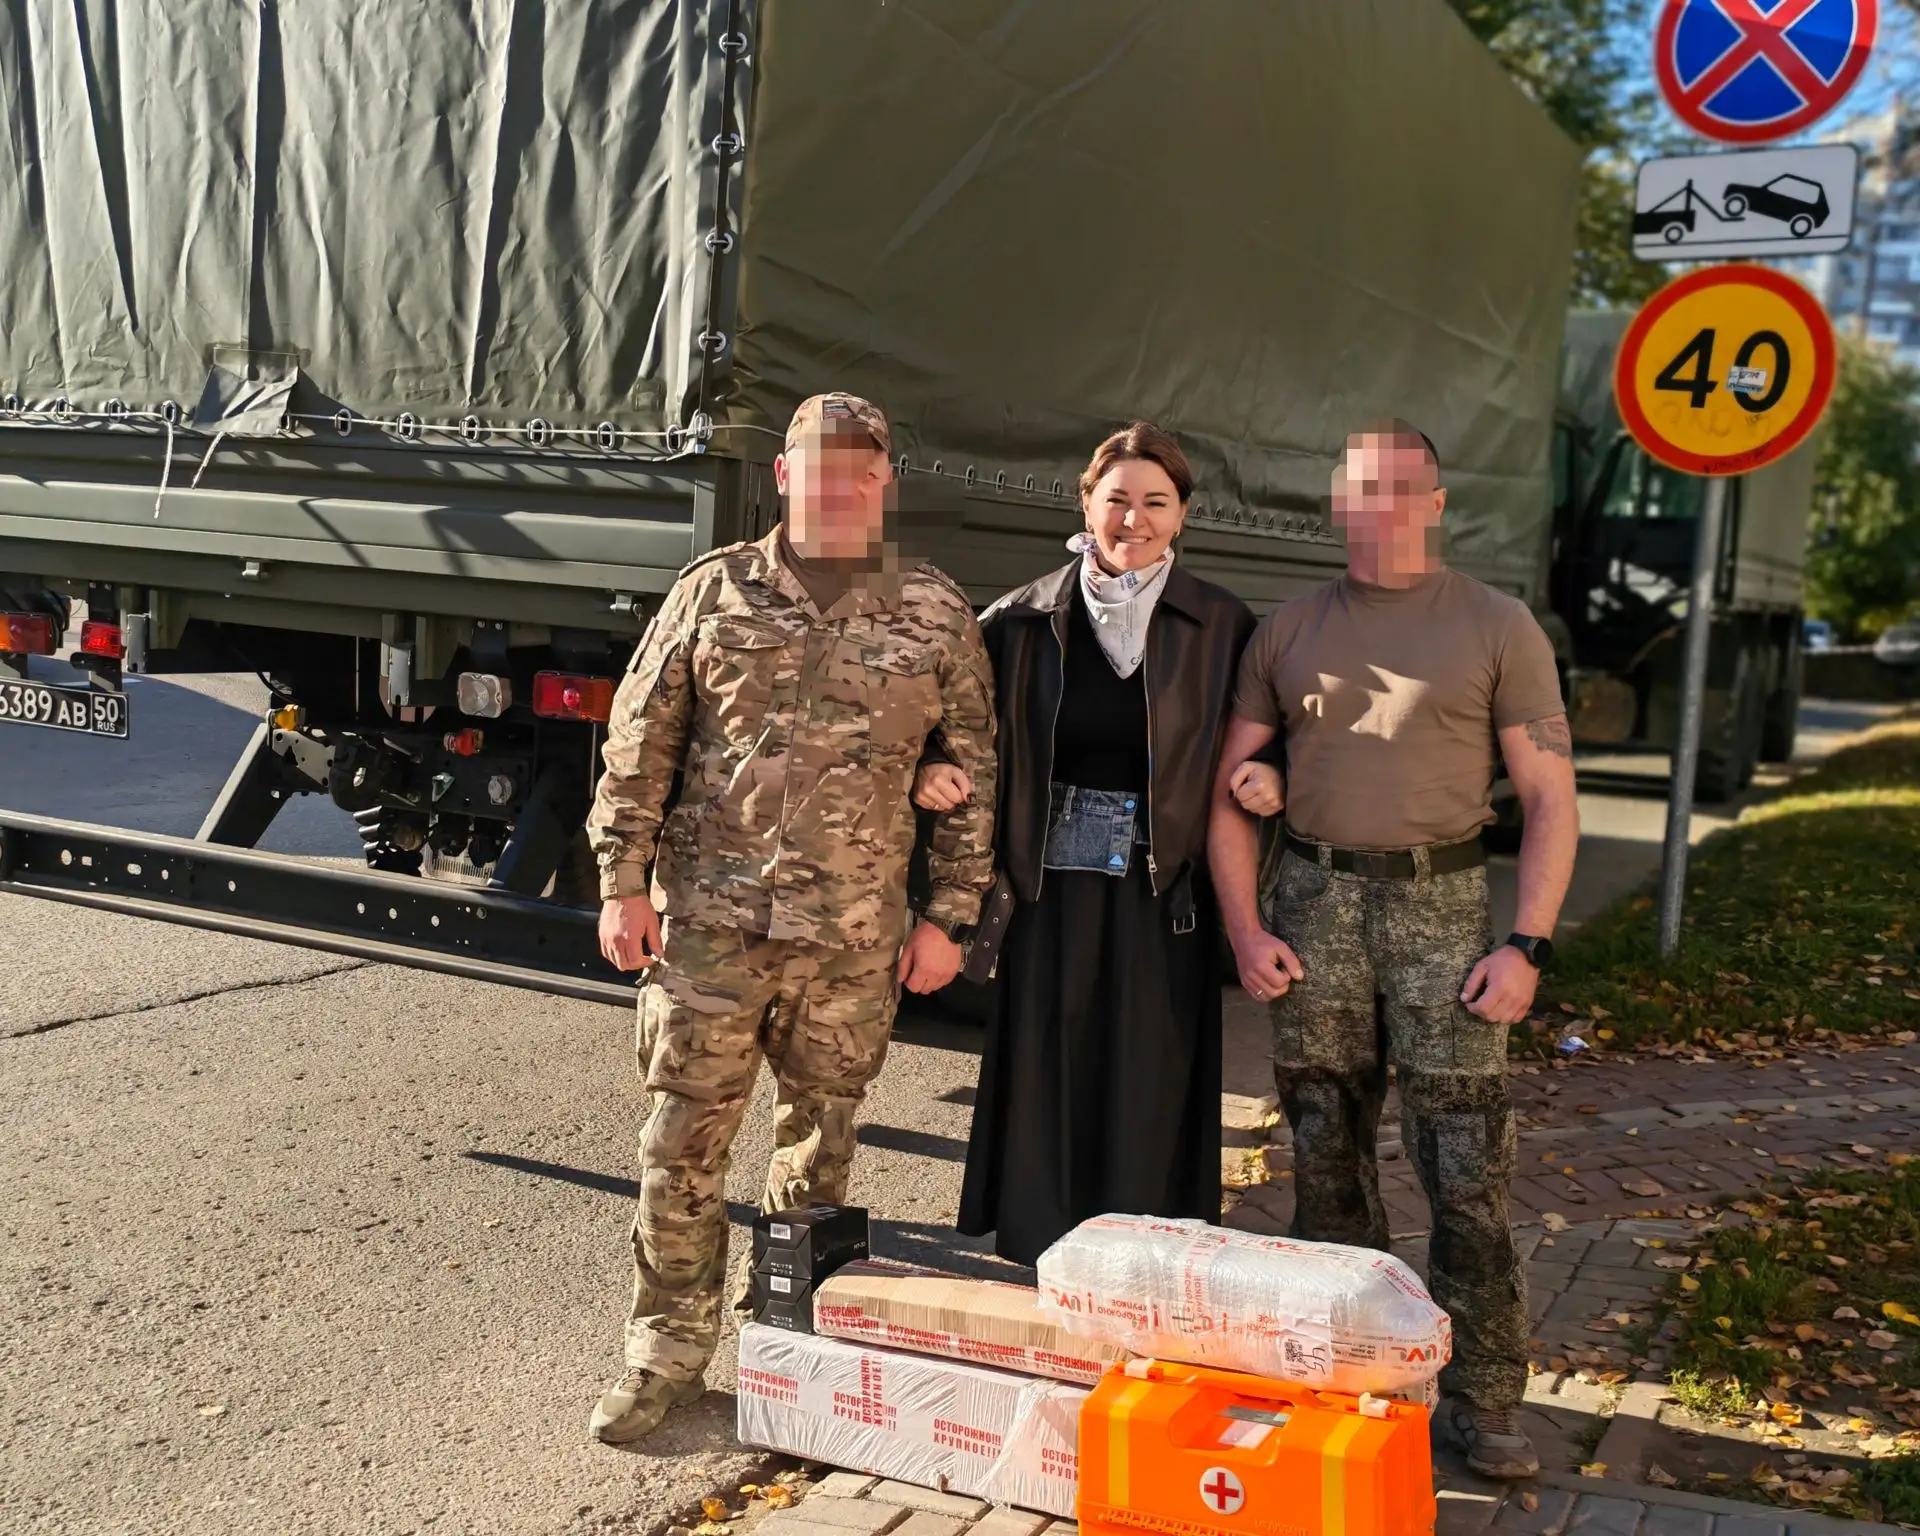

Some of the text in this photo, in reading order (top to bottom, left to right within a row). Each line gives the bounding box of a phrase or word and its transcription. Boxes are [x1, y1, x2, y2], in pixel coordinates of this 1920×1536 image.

[1654, 328, 1791, 413] 40
[93, 696, 119, 723] 50
[97, 721, 116, 733] RUS
[739, 1366, 799, 1391] ОСТОРОЖНО!!!
[933, 1418, 1002, 1446] ОСТОРОЖНО!!!
